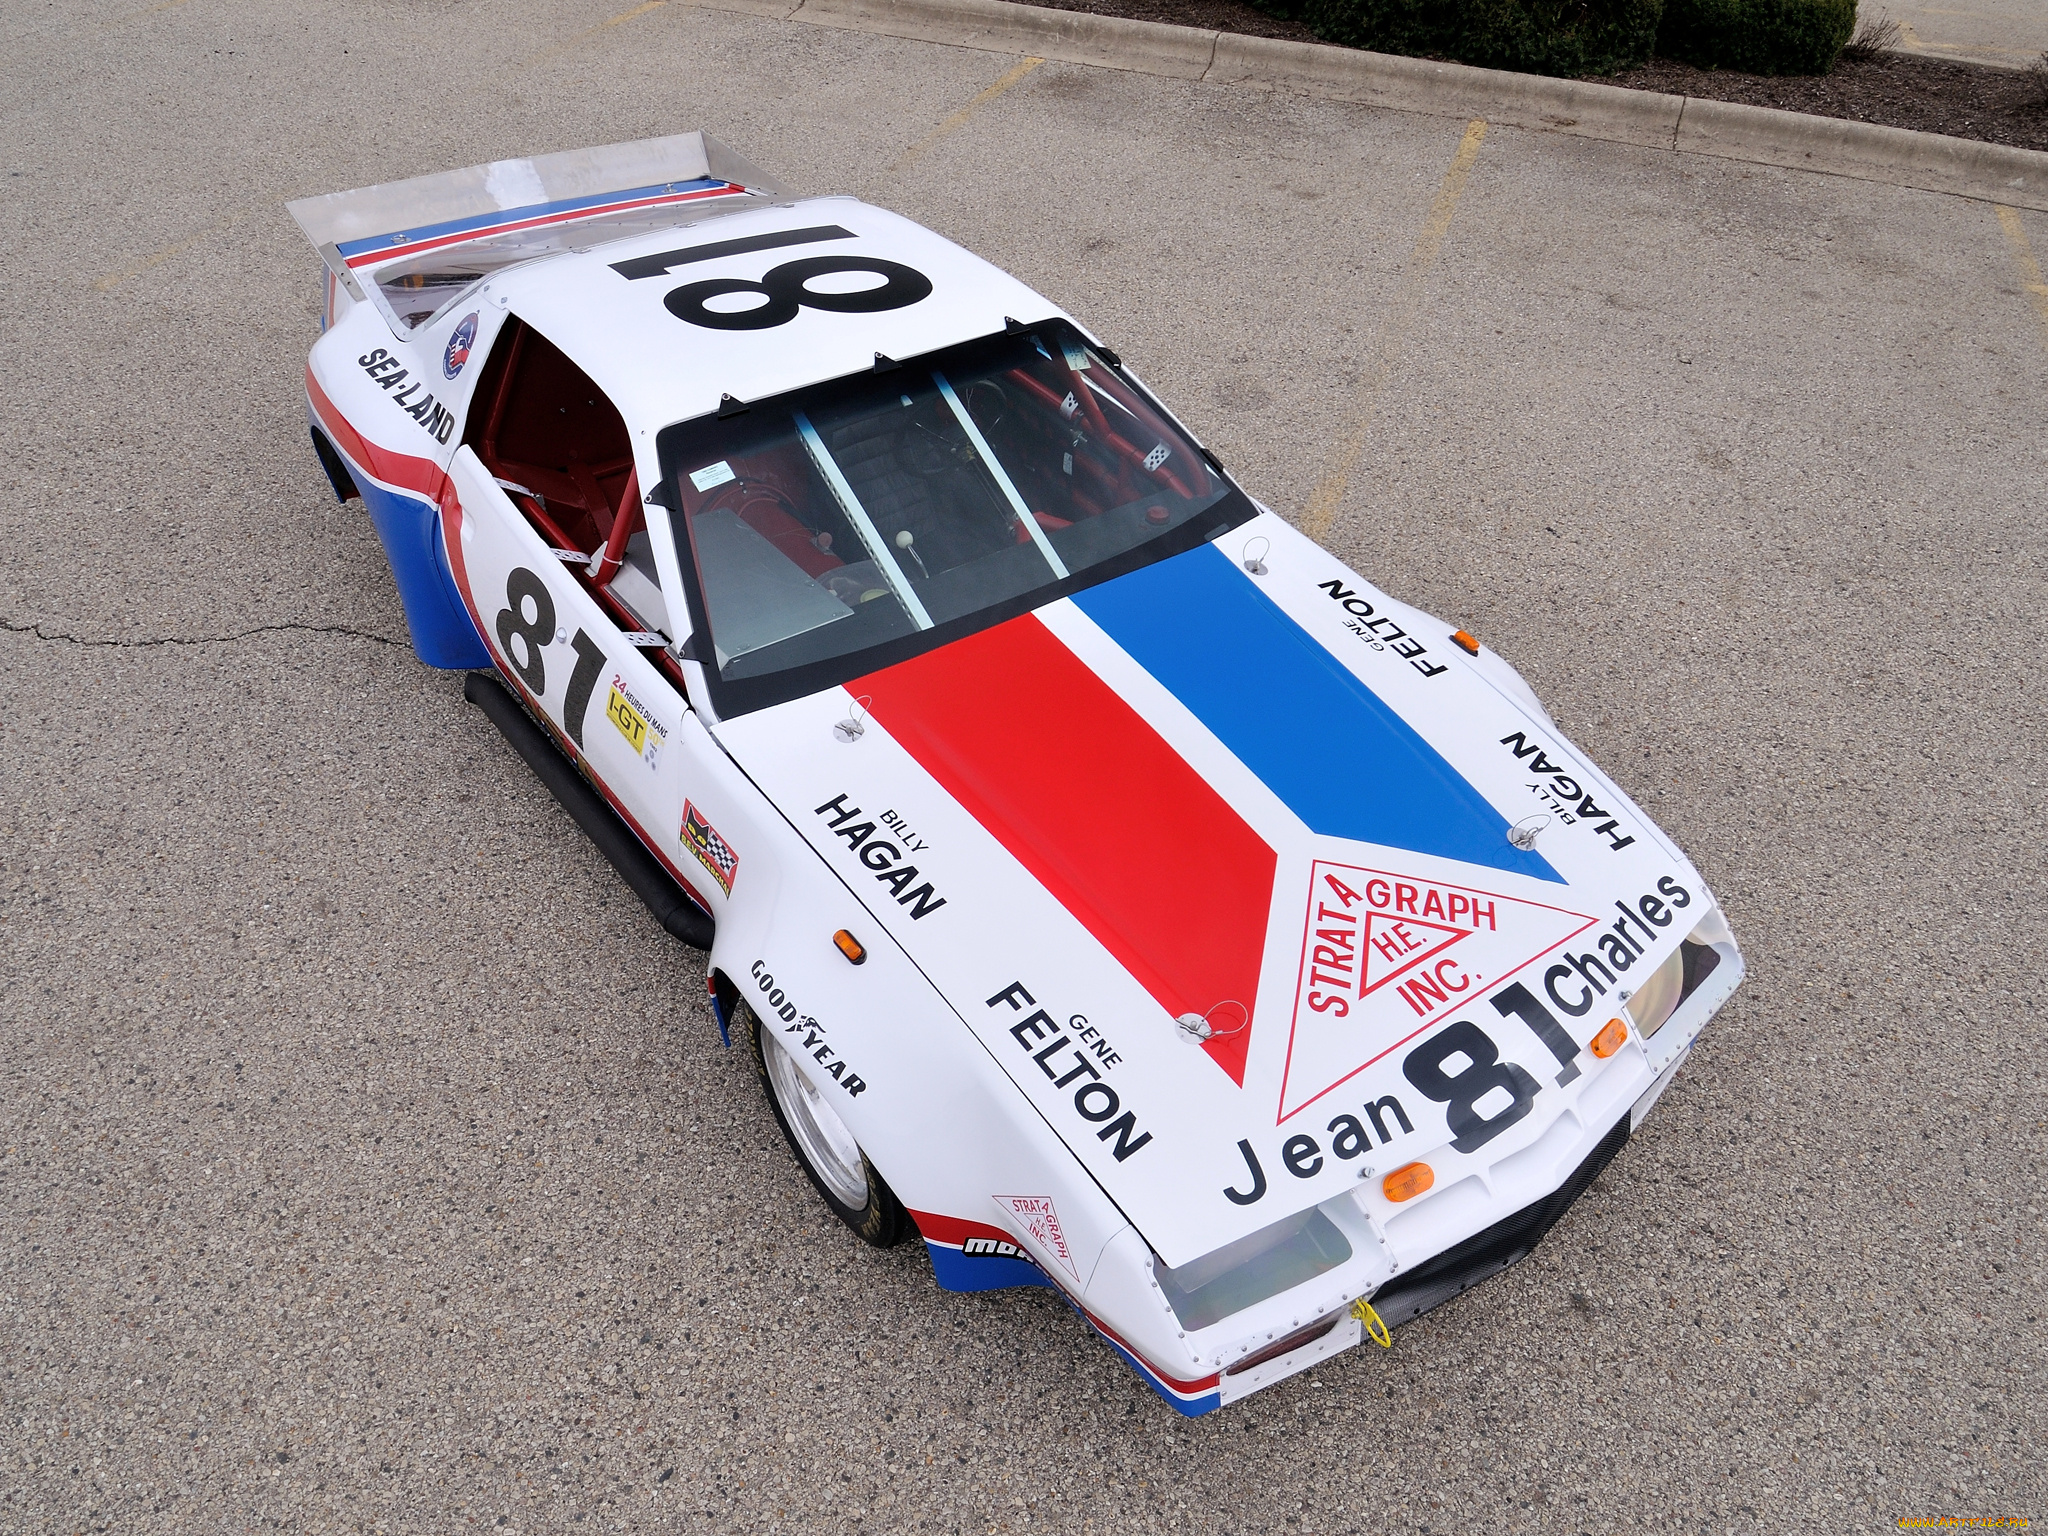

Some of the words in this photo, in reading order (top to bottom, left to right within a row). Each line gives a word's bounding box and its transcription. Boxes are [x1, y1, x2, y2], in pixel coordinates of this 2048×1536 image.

[608, 225, 933, 330] 81
[495, 566, 608, 753] 81
[1317, 579, 1449, 678] FELTON
[1342, 618, 1385, 651] GENE
[609, 691, 644, 740] I-GT
[612, 674, 627, 694] 24
[624, 690, 645, 714] HEURES
[643, 710, 653, 723] DU
[650, 718, 668, 738] MANS
[880, 809, 930, 853] BILLY
[1499, 731, 1636, 852] HAGAN
[1525, 783, 1577, 826] BILLY
[814, 793, 948, 921] HAGAN
[1397, 958, 1483, 1018] INC.
[985, 980, 1154, 1163] FELTON
[1069, 1014, 1123, 1070] GENE
[1223, 1096, 1415, 1206] Jean
[1402, 982, 1582, 1155] 81
[1544, 875, 1691, 1017] Charles
